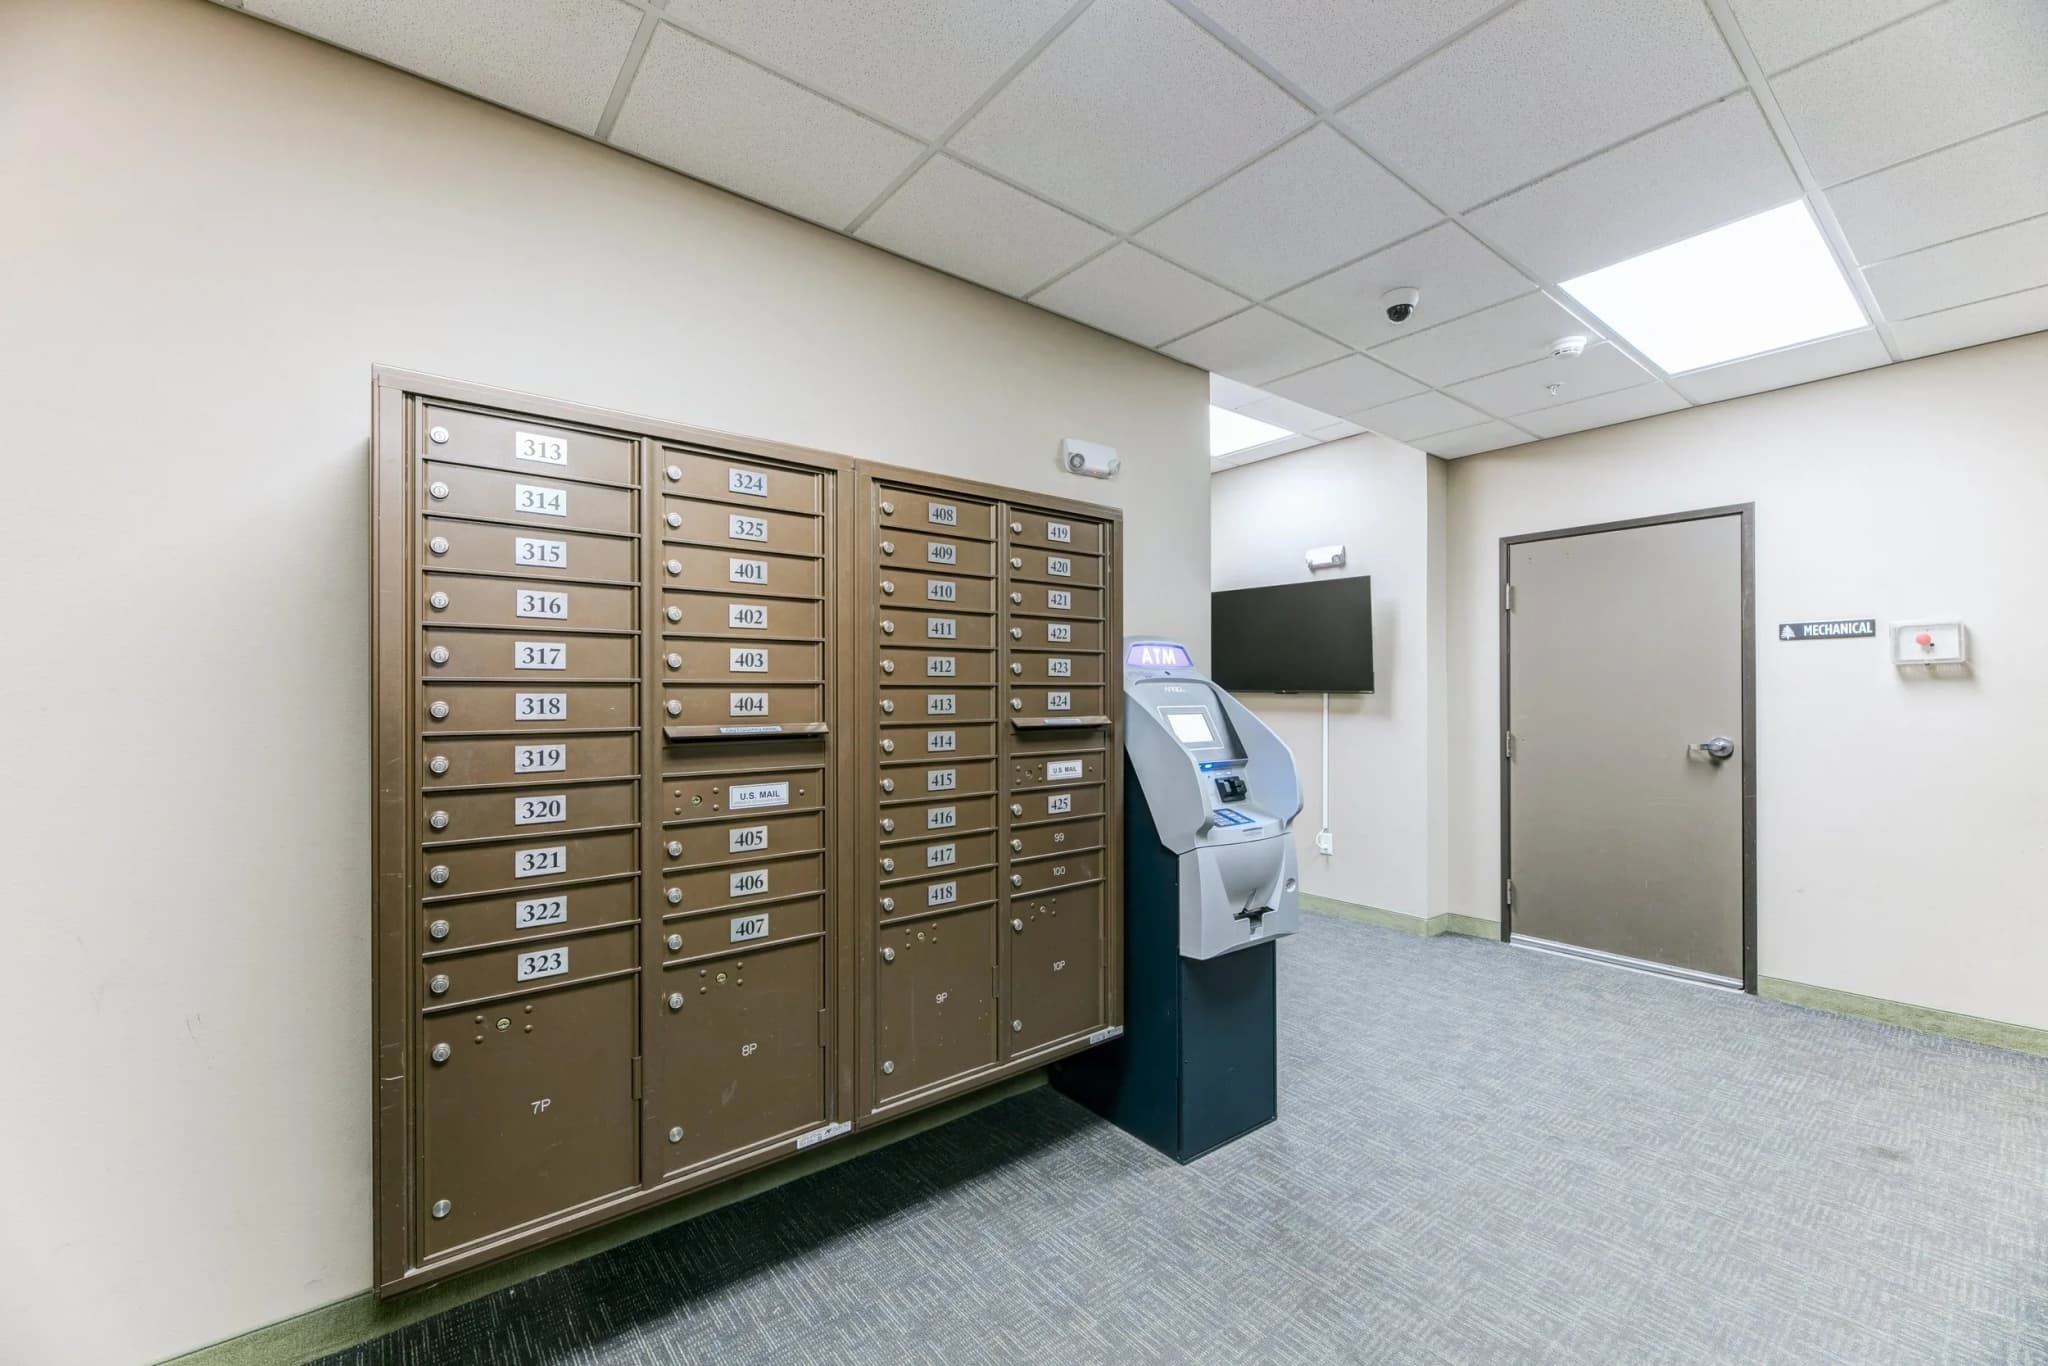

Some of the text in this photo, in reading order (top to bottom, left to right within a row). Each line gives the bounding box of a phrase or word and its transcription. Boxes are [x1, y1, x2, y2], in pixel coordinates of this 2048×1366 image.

[523, 438, 562, 461] 313
[734, 473, 763, 491] 324
[522, 489, 561, 512] 314
[932, 507, 954, 522] 408
[735, 519, 764, 538] 325
[1050, 526, 1068, 539] 419
[522, 542, 561, 563] 315
[931, 546, 953, 560] 409
[734, 563, 763, 580] 401
[1050, 560, 1069, 574] 420
[930, 584, 953, 599] 410
[522, 594, 562, 614] 316
[1050, 593, 1068, 607] 421
[734, 609, 763, 625] 402
[931, 622, 952, 636] 411
[1050, 627, 1068, 640] 422
[1803, 621, 1873, 636] MECHANICAL
[522, 646, 561, 665] 317
[734, 652, 764, 668] 403
[1142, 648, 1176, 665] ATM
[930, 659, 952, 673] 412
[1050, 661, 1069, 674] 423
[521, 697, 561, 715] 318
[733, 696, 764, 712] 404
[930, 697, 953, 712] 413
[1049, 695, 1068, 707] 424
[930, 735, 953, 748] 414
[521, 749, 561, 768] 319
[931, 772, 953, 787] 415
[740, 792, 757, 801] U.S.
[759, 790, 780, 799] MAIL
[522, 799, 561, 820] 320
[1050, 797, 1069, 811] 425
[930, 811, 953, 825] 416
[734, 830, 763, 847] 405
[1053, 832, 1065, 843] 99
[522, 851, 561, 872] 321
[930, 847, 953, 863] 417
[1052, 865, 1066, 876] 100
[734, 873, 764, 892] 406
[930, 885, 953, 901] 418
[523, 902, 561, 922] 322
[735, 918, 765, 937] 407
[523, 954, 562, 975] 323
[1052, 959, 1066, 972] 10P
[935, 991, 948, 1004] 9P
[741, 1042, 758, 1057] 8P
[530, 1098, 551, 1115] 7P
